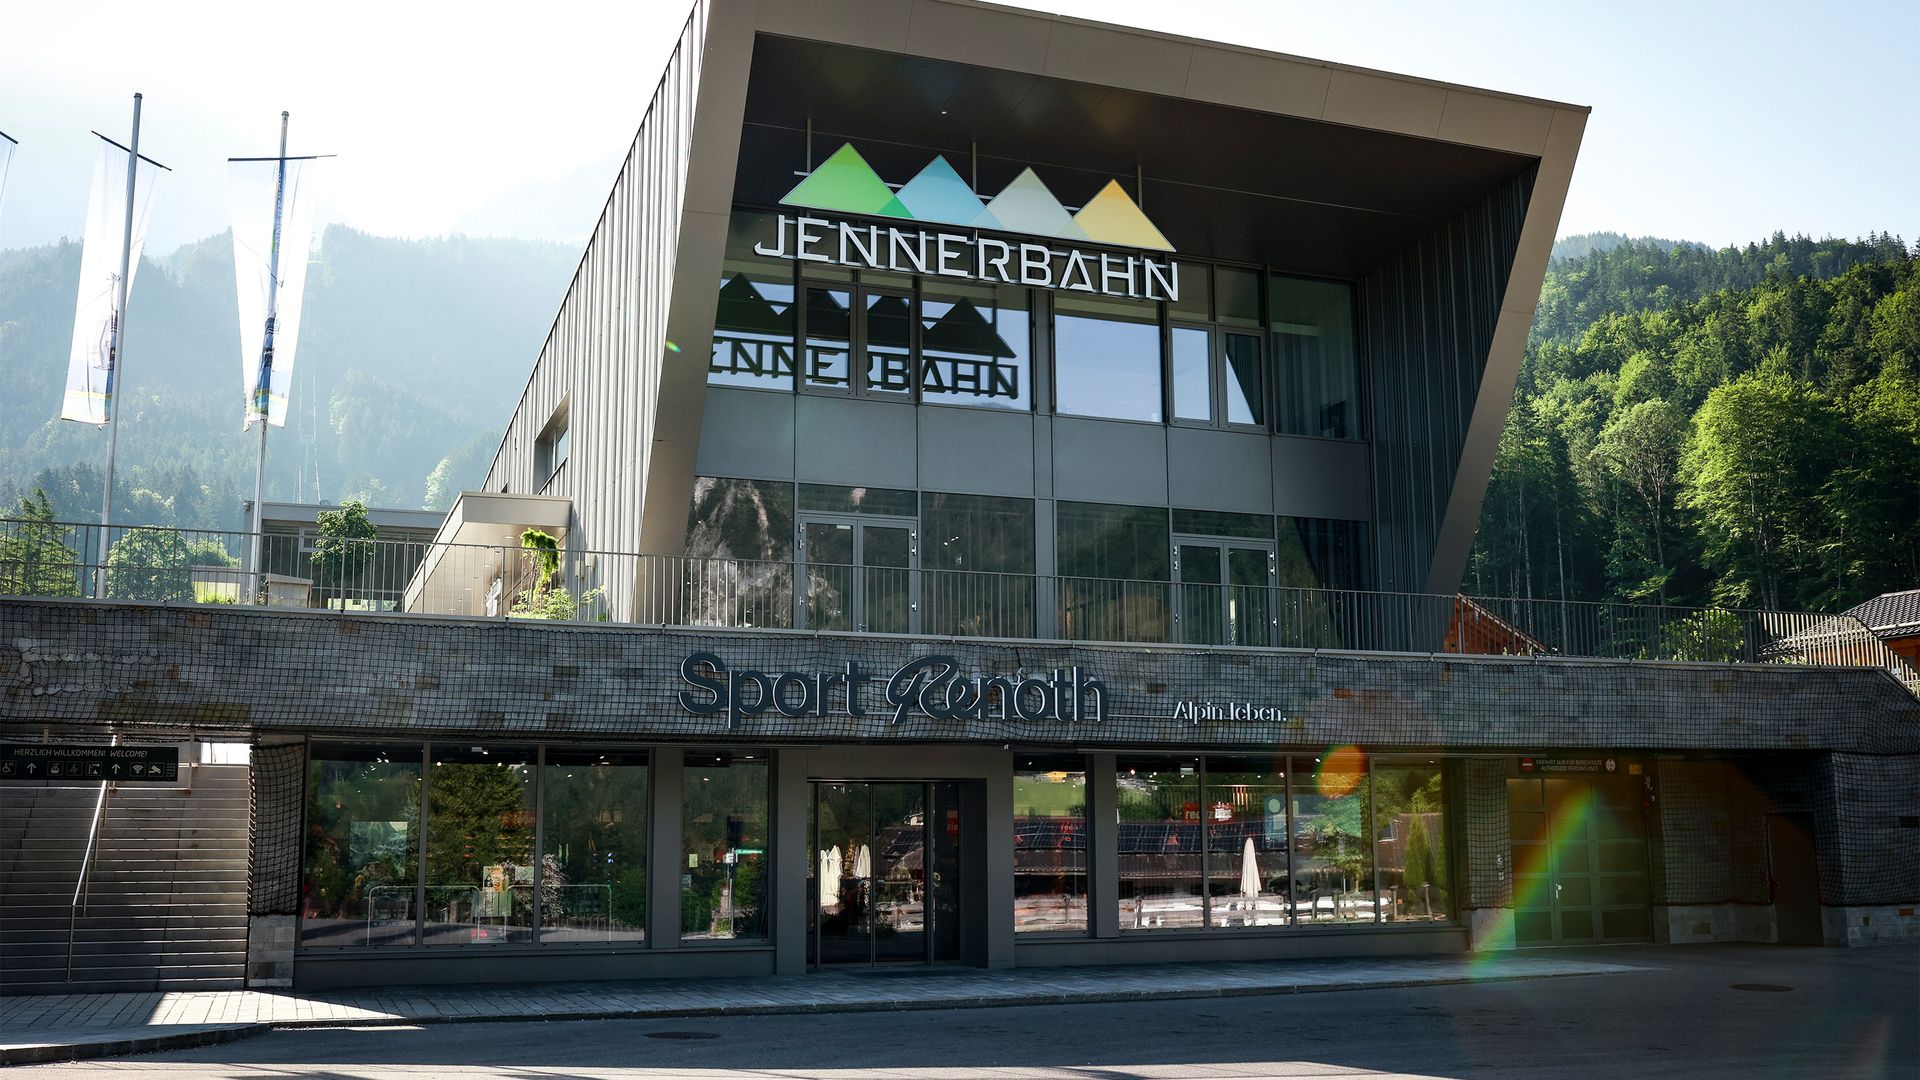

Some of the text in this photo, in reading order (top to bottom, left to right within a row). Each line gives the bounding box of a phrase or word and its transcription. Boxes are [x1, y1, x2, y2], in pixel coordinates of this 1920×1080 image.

[754, 214, 1179, 301] JENNERBAHN
[679, 653, 1108, 729] Sport Renoth
[1173, 700, 1287, 724] Alpin leben.
[14, 748, 148, 758] HERZLICH WILLKOMMEN! WELCOME!
